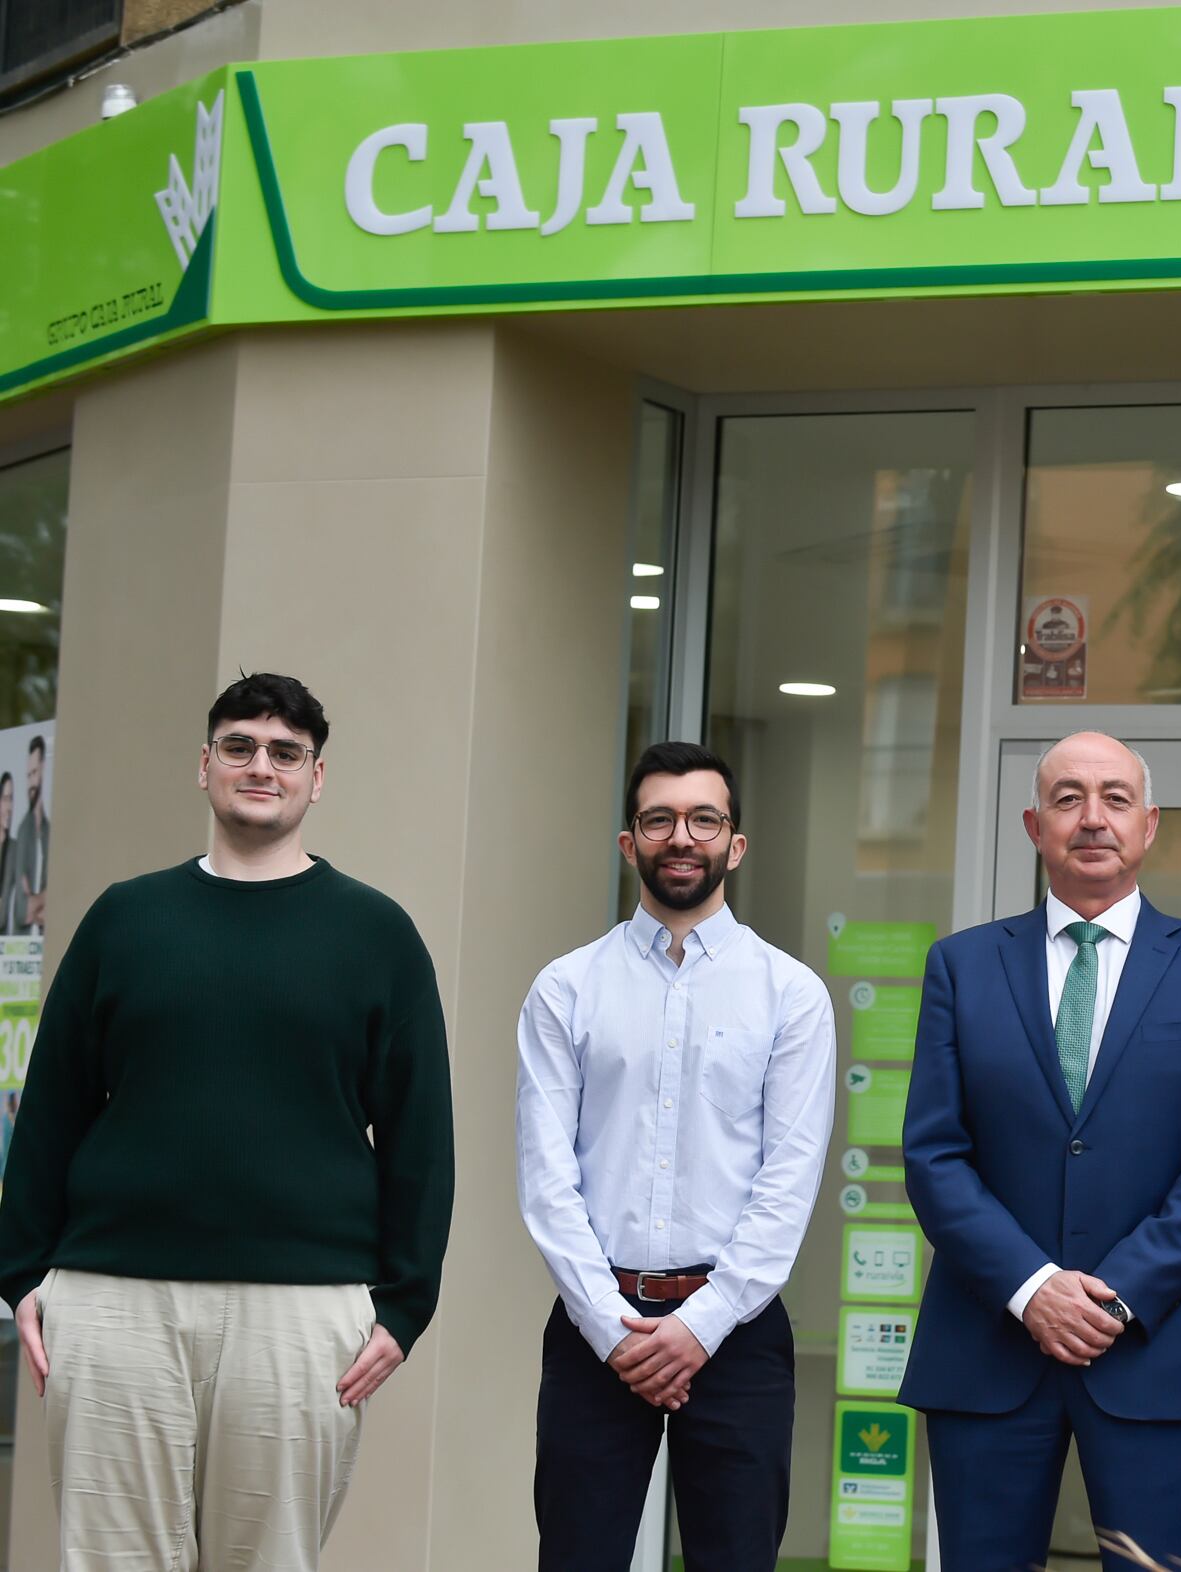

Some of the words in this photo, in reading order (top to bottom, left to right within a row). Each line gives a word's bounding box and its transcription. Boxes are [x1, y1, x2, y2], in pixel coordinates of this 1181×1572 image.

[344, 110, 696, 237] CAJA
[90, 298, 118, 330] CAJA
[121, 281, 164, 320] RURAL
